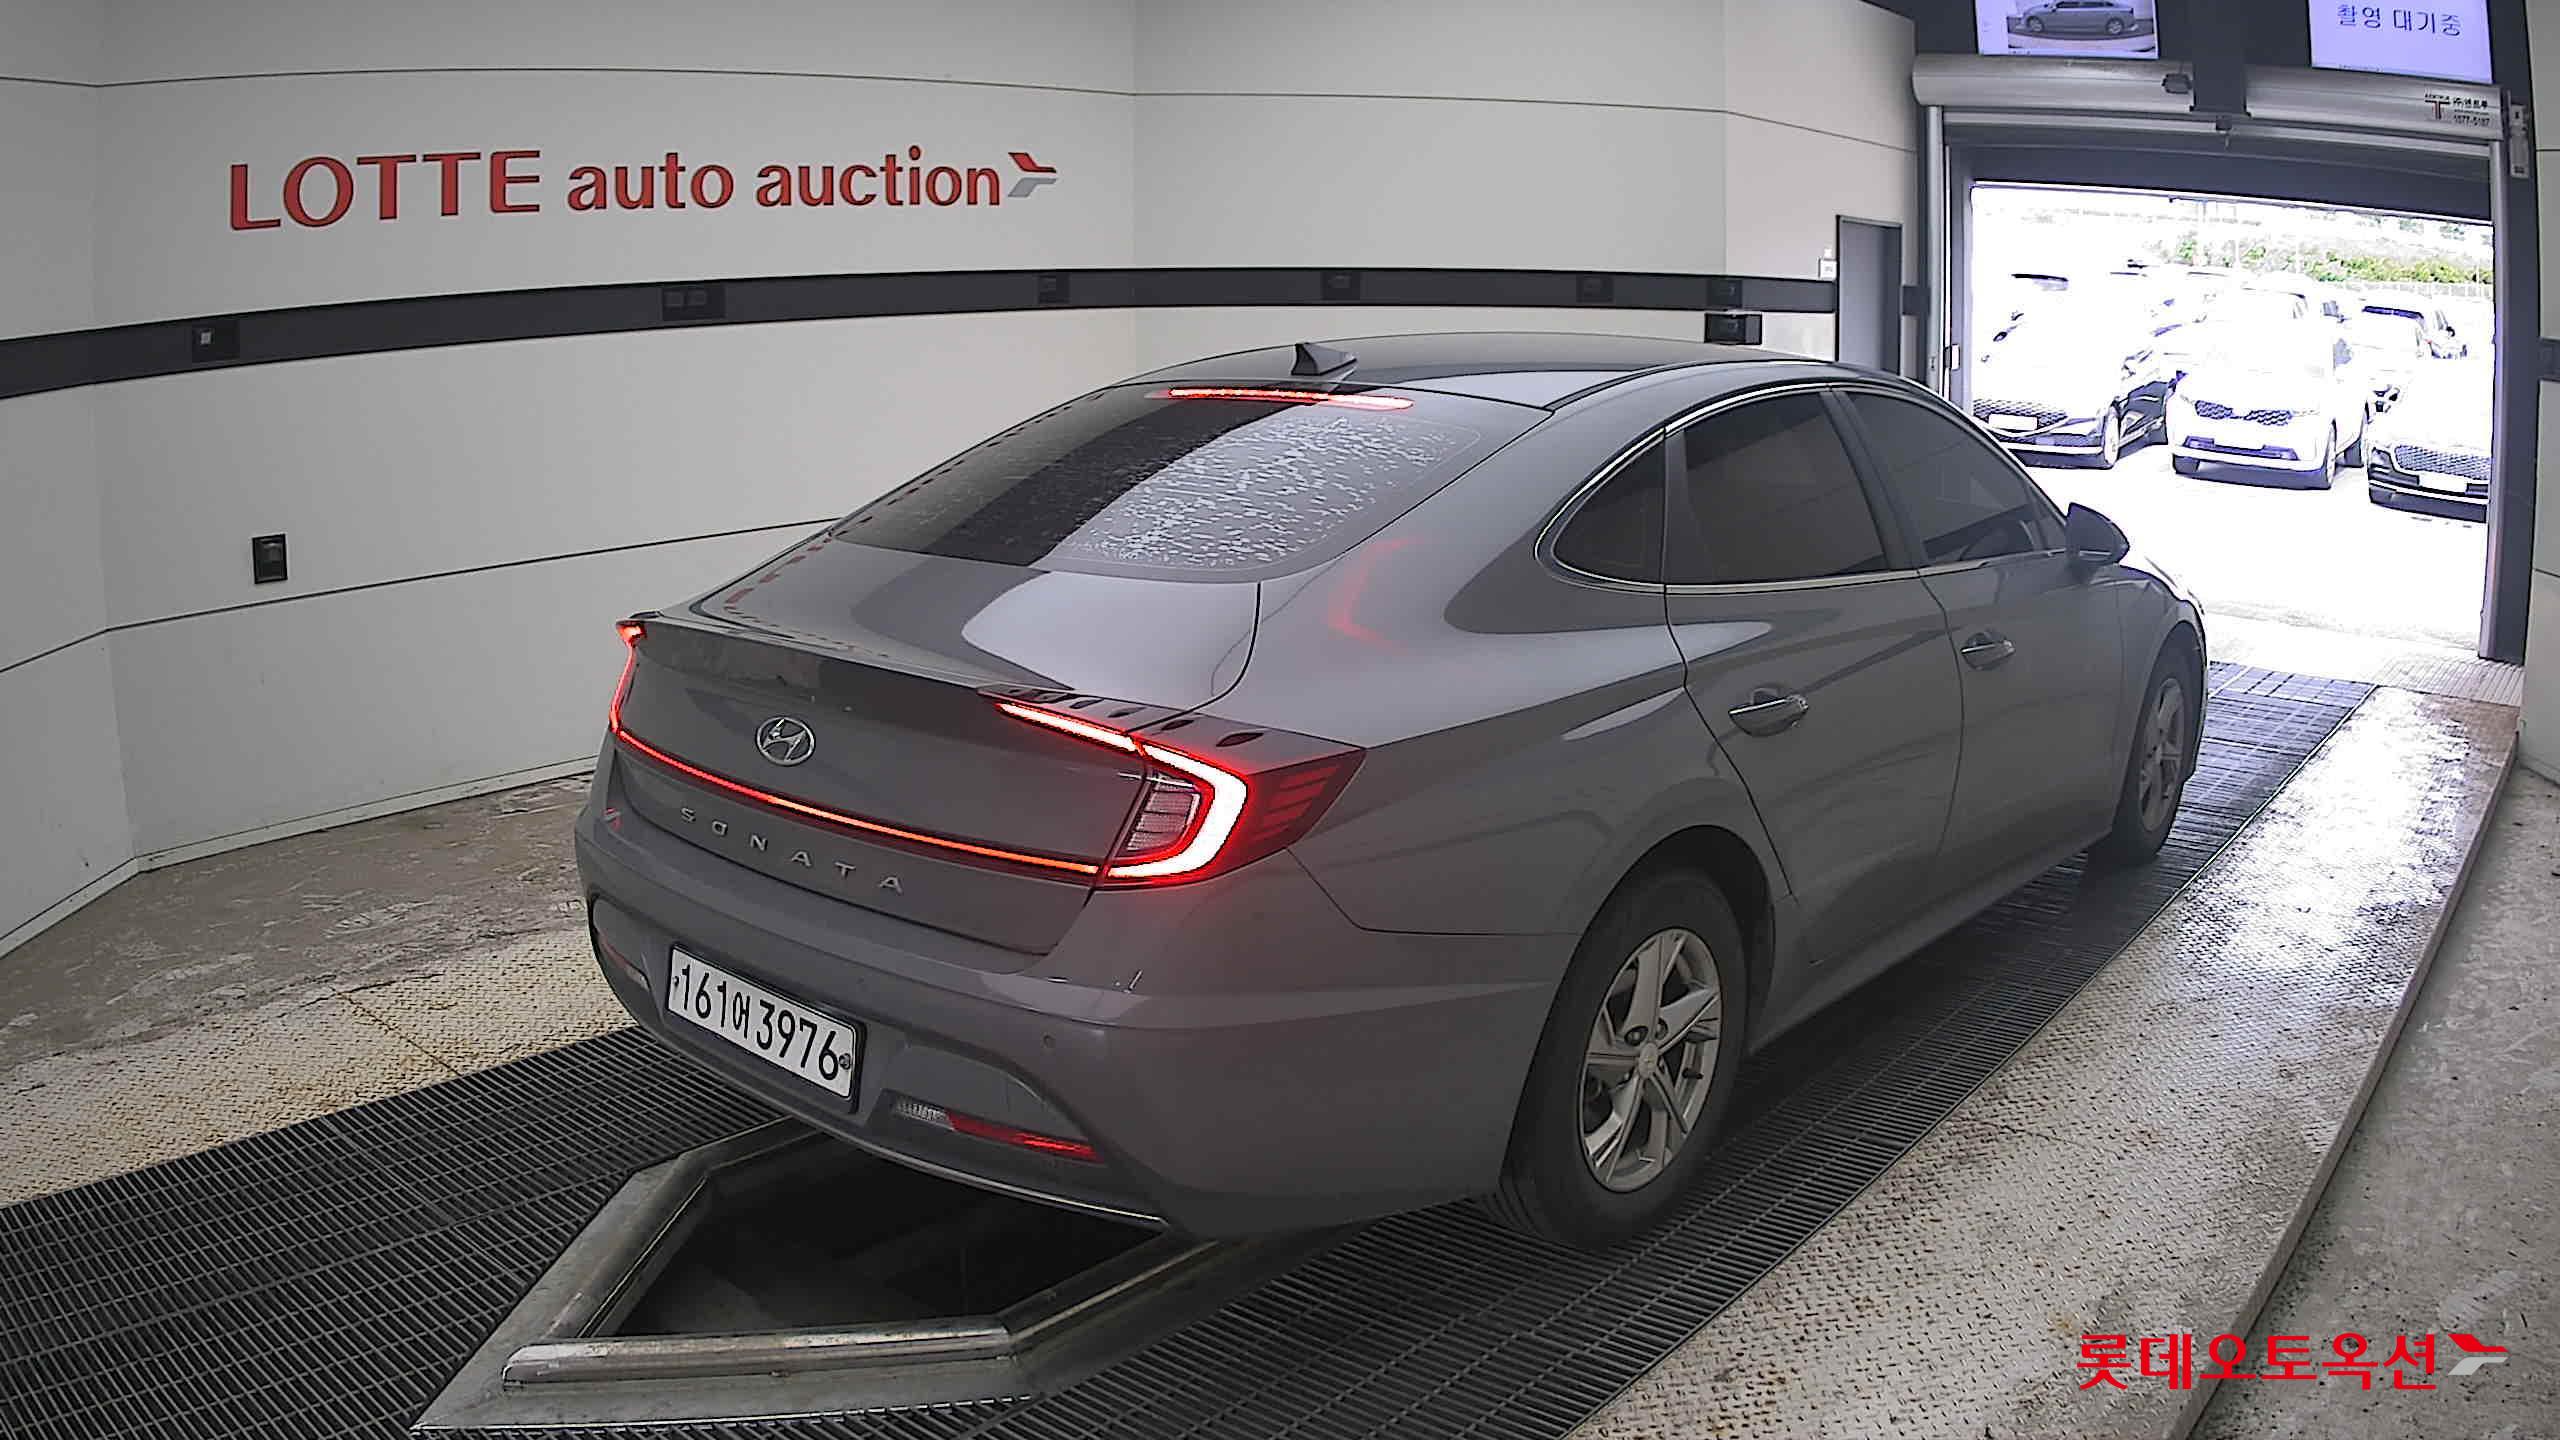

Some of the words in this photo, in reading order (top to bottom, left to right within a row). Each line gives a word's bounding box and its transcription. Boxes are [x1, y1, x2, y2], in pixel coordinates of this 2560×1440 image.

[2337, 4, 2382, 29] 촬영
[2392, 8, 2462, 37] 대기중
[230, 150, 541, 231] LOTTE
[567, 152, 735, 210] auto
[755, 145, 1001, 209] auction
[680, 807, 903, 894] SONATA
